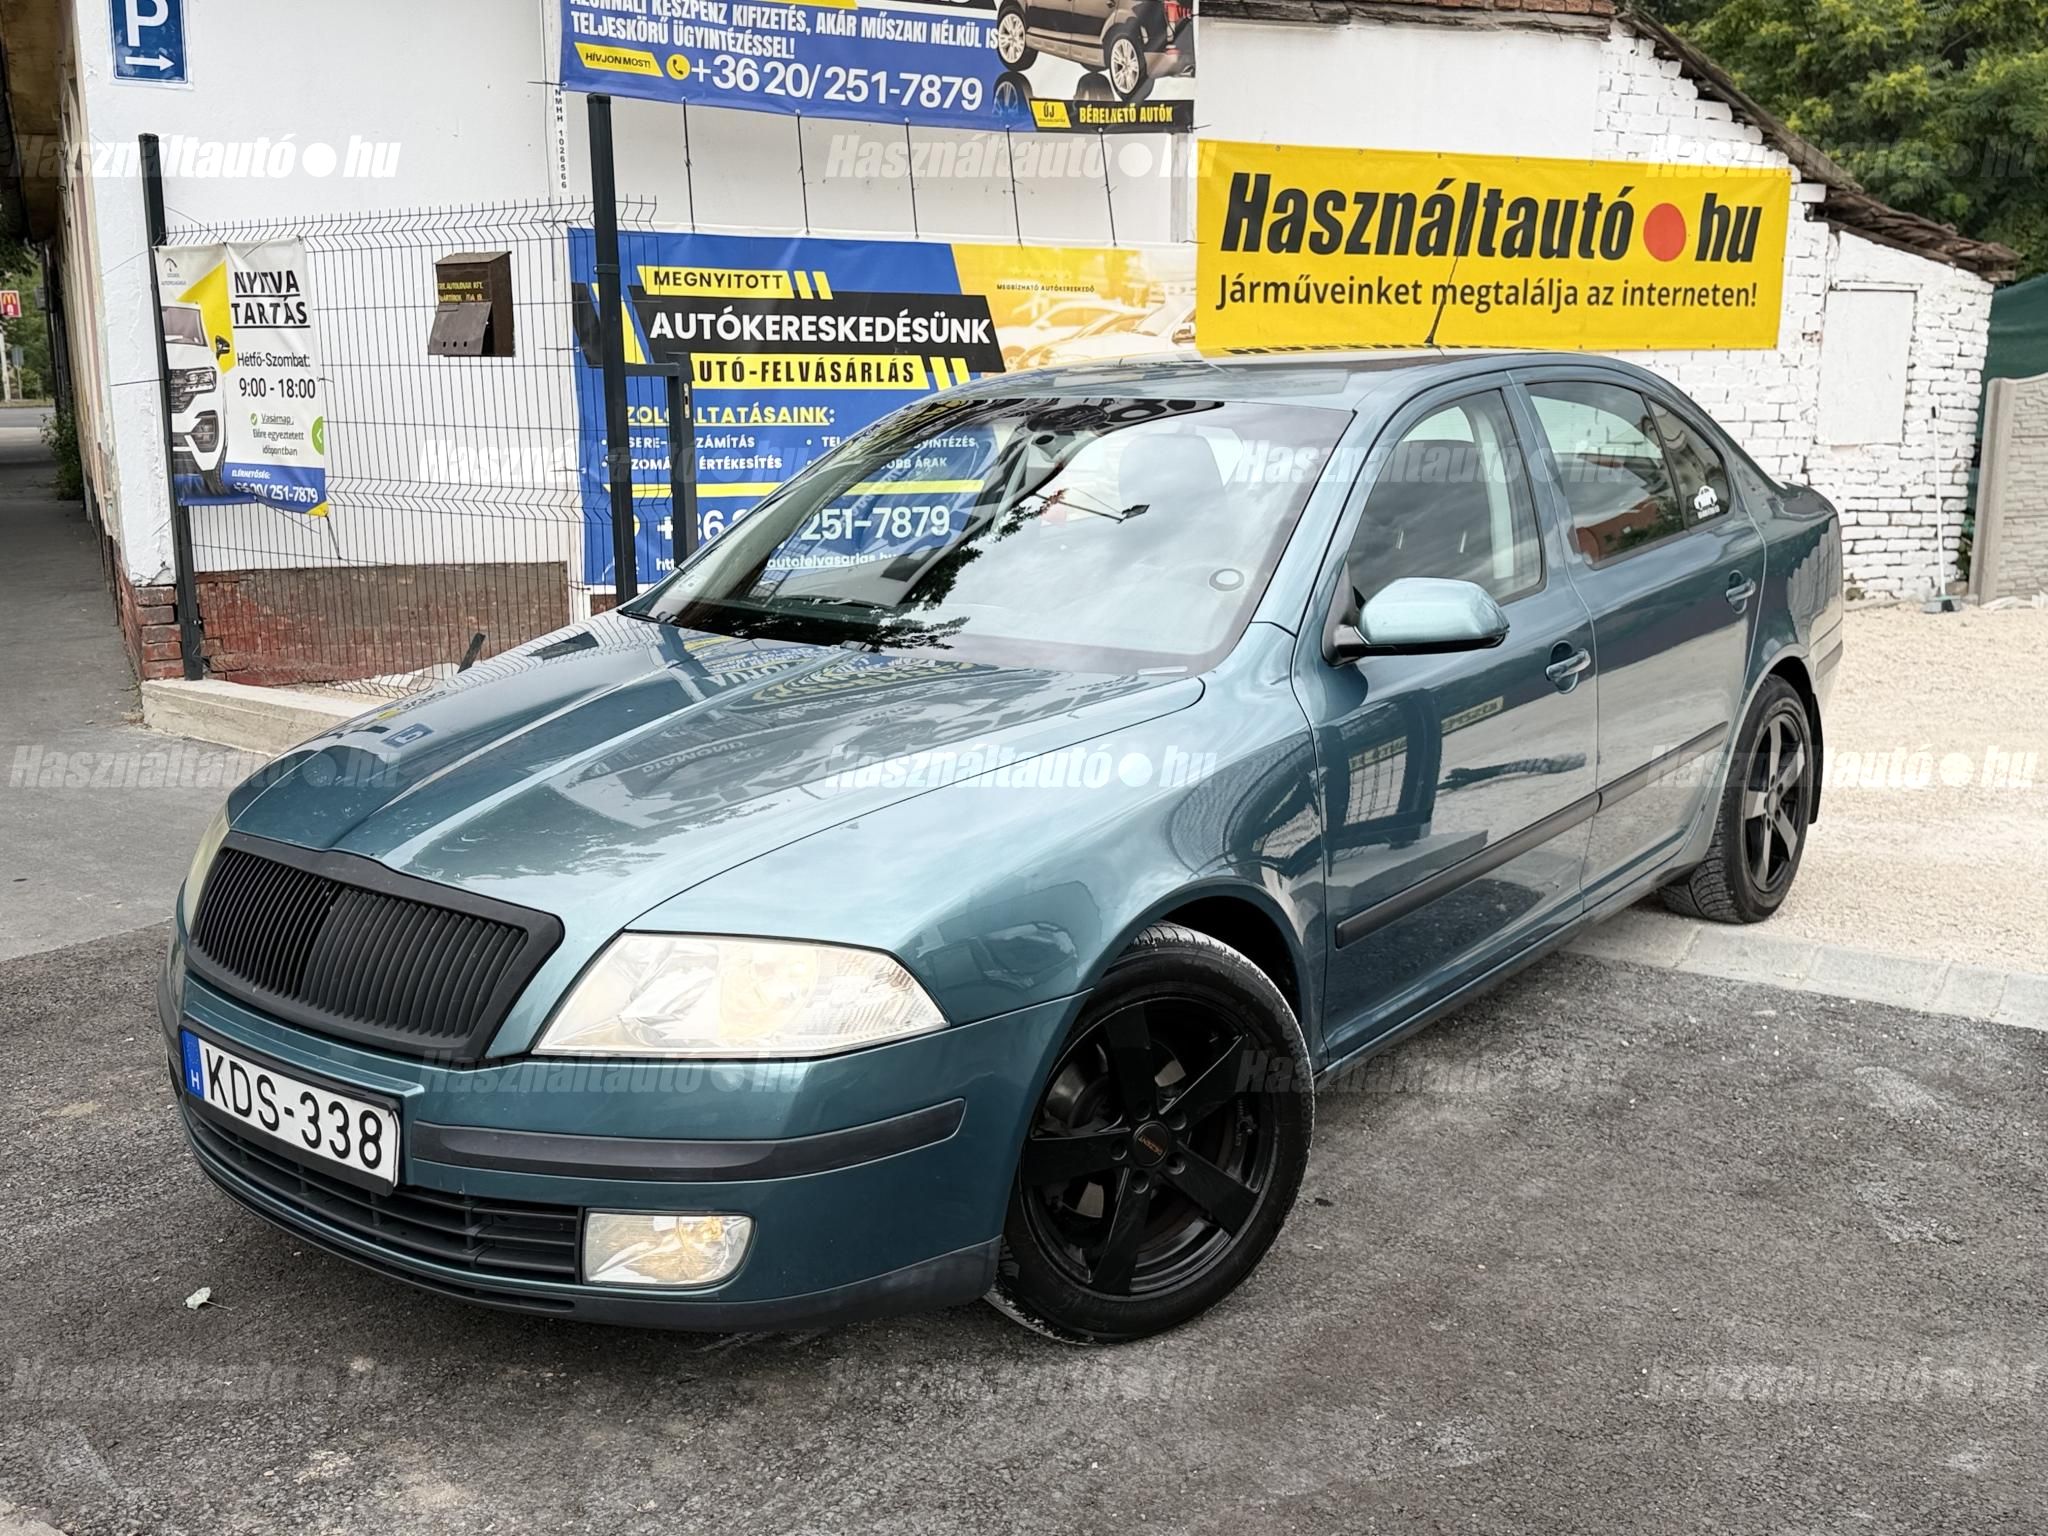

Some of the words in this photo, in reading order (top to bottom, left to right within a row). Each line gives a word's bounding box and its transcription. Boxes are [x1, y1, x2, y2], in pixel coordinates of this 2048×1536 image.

[125, 0, 168, 47] P
[570, 11, 669, 45] TELJESKÖRŰ
[673, 20, 795, 59] ÜGYINTÉZÉSSEL!
[732, 4, 811, 36] KIFIZETÉS,
[816, 10, 857, 37] AKÁR
[861, 11, 927, 44] MŰSZAKI
[931, 18, 982, 49] NÉLKÜL
[585, 50, 622, 66] HÍVJON
[622, 56, 651, 69] MOST!
[690, 54, 759, 92] +36
[234, 270, 300, 293] NYITVA
[653, 271, 783, 289] MEGNYITOTT
[1216, 272, 1422, 310] Járműveinket
[1432, 277, 1578, 314] megtalálja
[1586, 287, 1614, 306] az
[1622, 280, 1757, 307] interneten!
[231, 296, 308, 325] TARTÁS
[650, 305, 991, 344] AUTÓKERESKEDÉSÜNK
[237, 352, 311, 368] Hétfő-Szombat:
[692, 355, 914, 383] UTÓ-FELVÁSÁRLÁS
[239, 377, 267, 397] 9:00
[278, 378, 316, 399] 18:00
[699, 455, 783, 470] ÉRTÉKESÍTÉS
[190, 1069, 200, 1090] H
[205, 1048, 383, 1170] KDS-338
